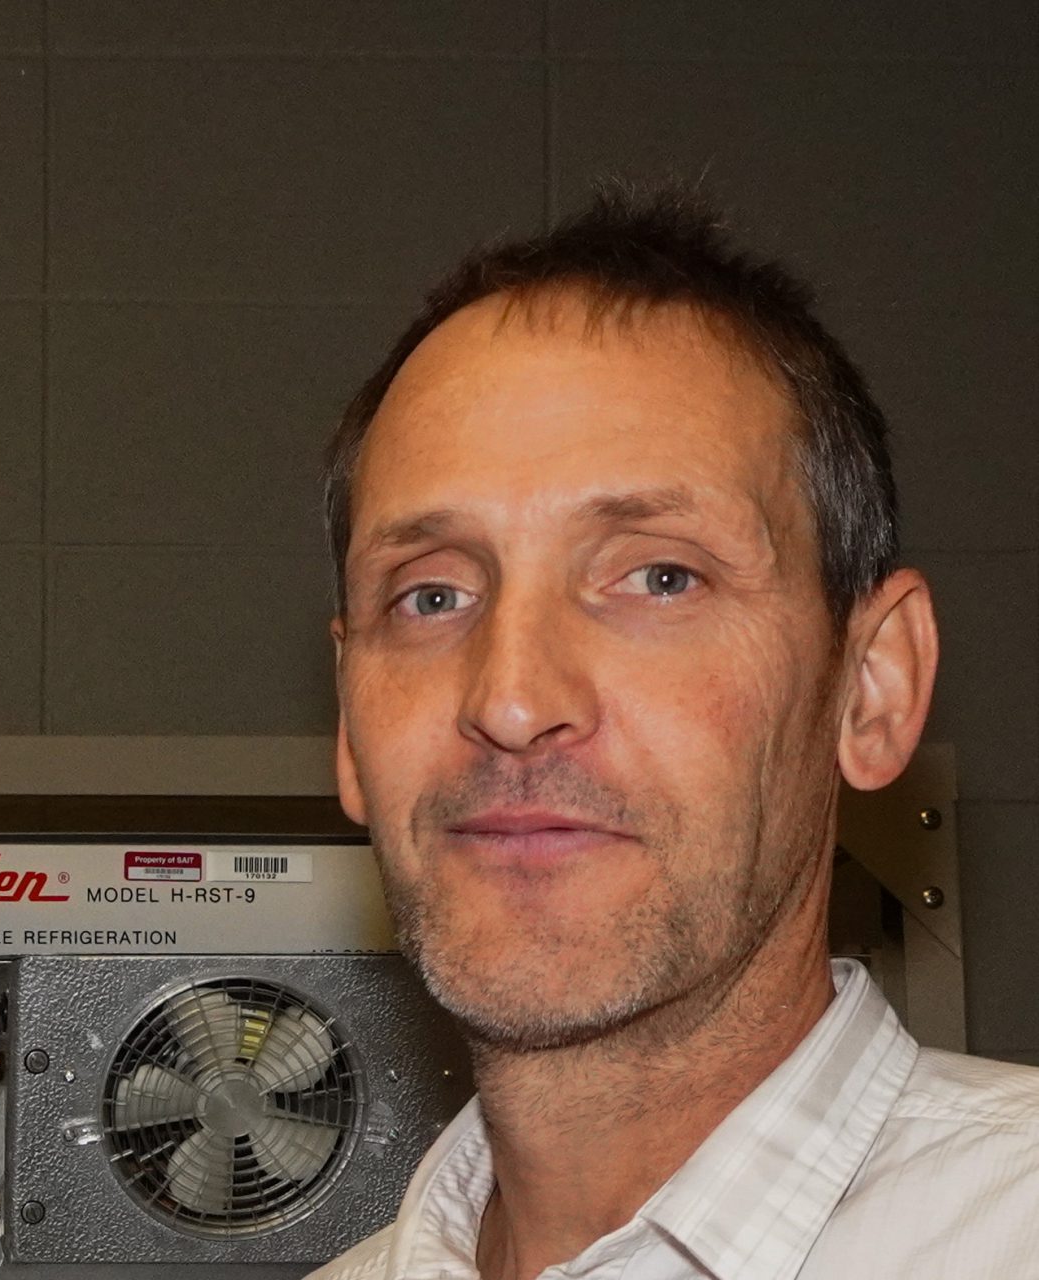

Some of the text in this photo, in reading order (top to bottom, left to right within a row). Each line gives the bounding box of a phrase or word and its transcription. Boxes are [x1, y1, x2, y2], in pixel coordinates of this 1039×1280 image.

[134, 855, 195, 865] Property of SAIT
[87, 887, 256, 904] MODEL H-RST-9
[24, 930, 177, 945] REFRIGERATION
